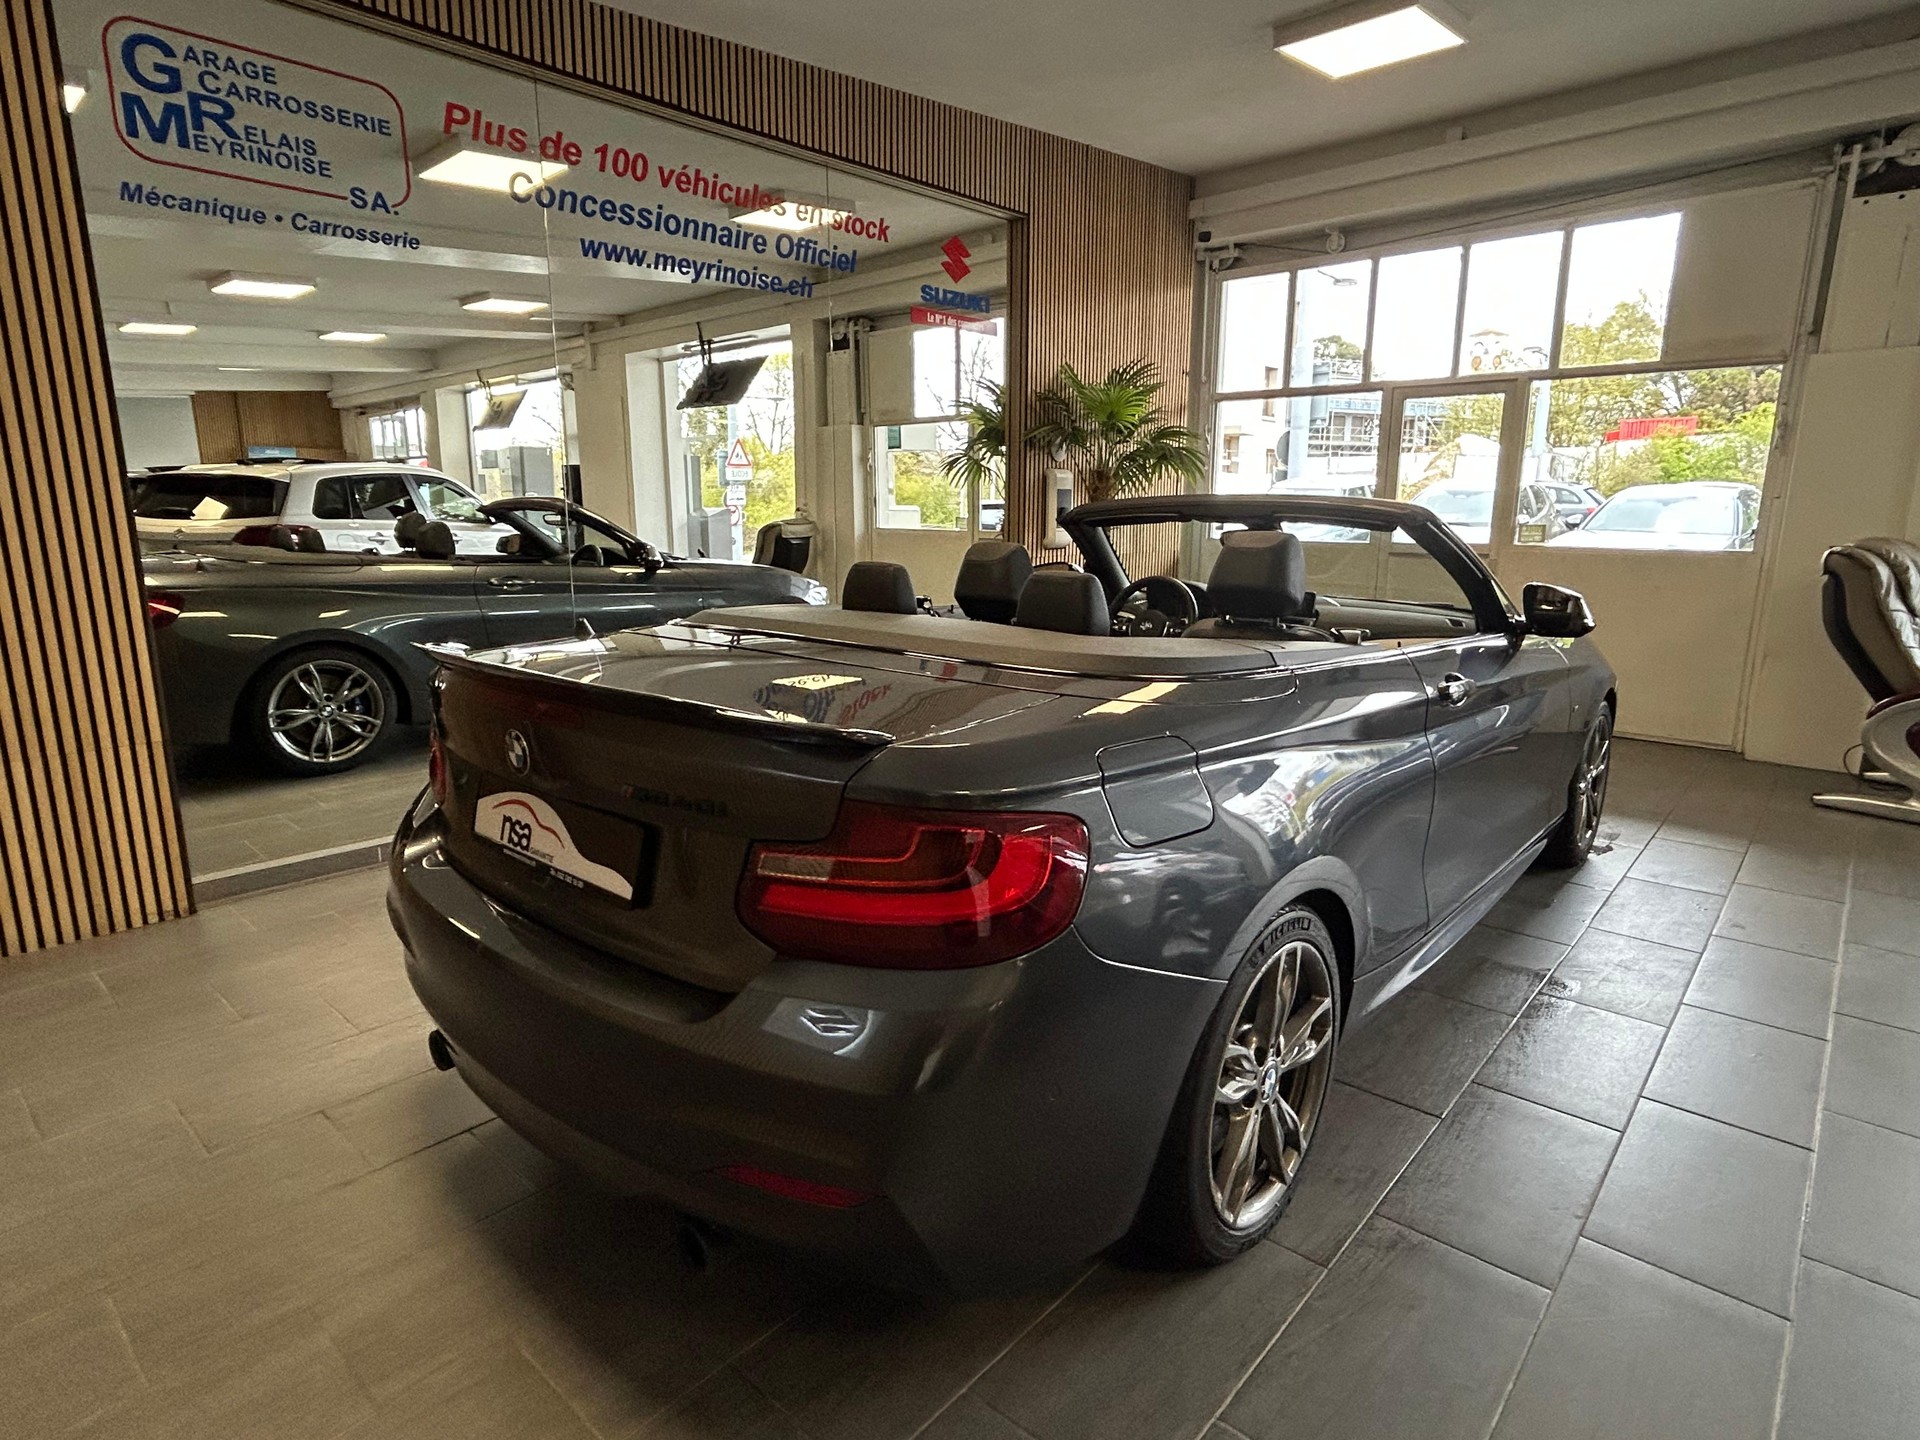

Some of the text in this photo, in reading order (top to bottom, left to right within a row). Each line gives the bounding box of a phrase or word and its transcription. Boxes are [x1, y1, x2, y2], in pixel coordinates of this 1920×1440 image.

[121, 33, 278, 94] GARAGE
[198, 70, 392, 137] CARROSSERIE
[349, 186, 400, 216] SA.
[443, 101, 891, 243] Plus de 100 véhicules en stock
[119, 181, 420, 250] Mécanique Carrosserie
[508, 171, 857, 273] Concessionnaire Officiel
[579, 237, 813, 298] www.meyrinoise.ch
[920, 284, 990, 313] SUZUKI
[500, 813, 532, 851] nsa
